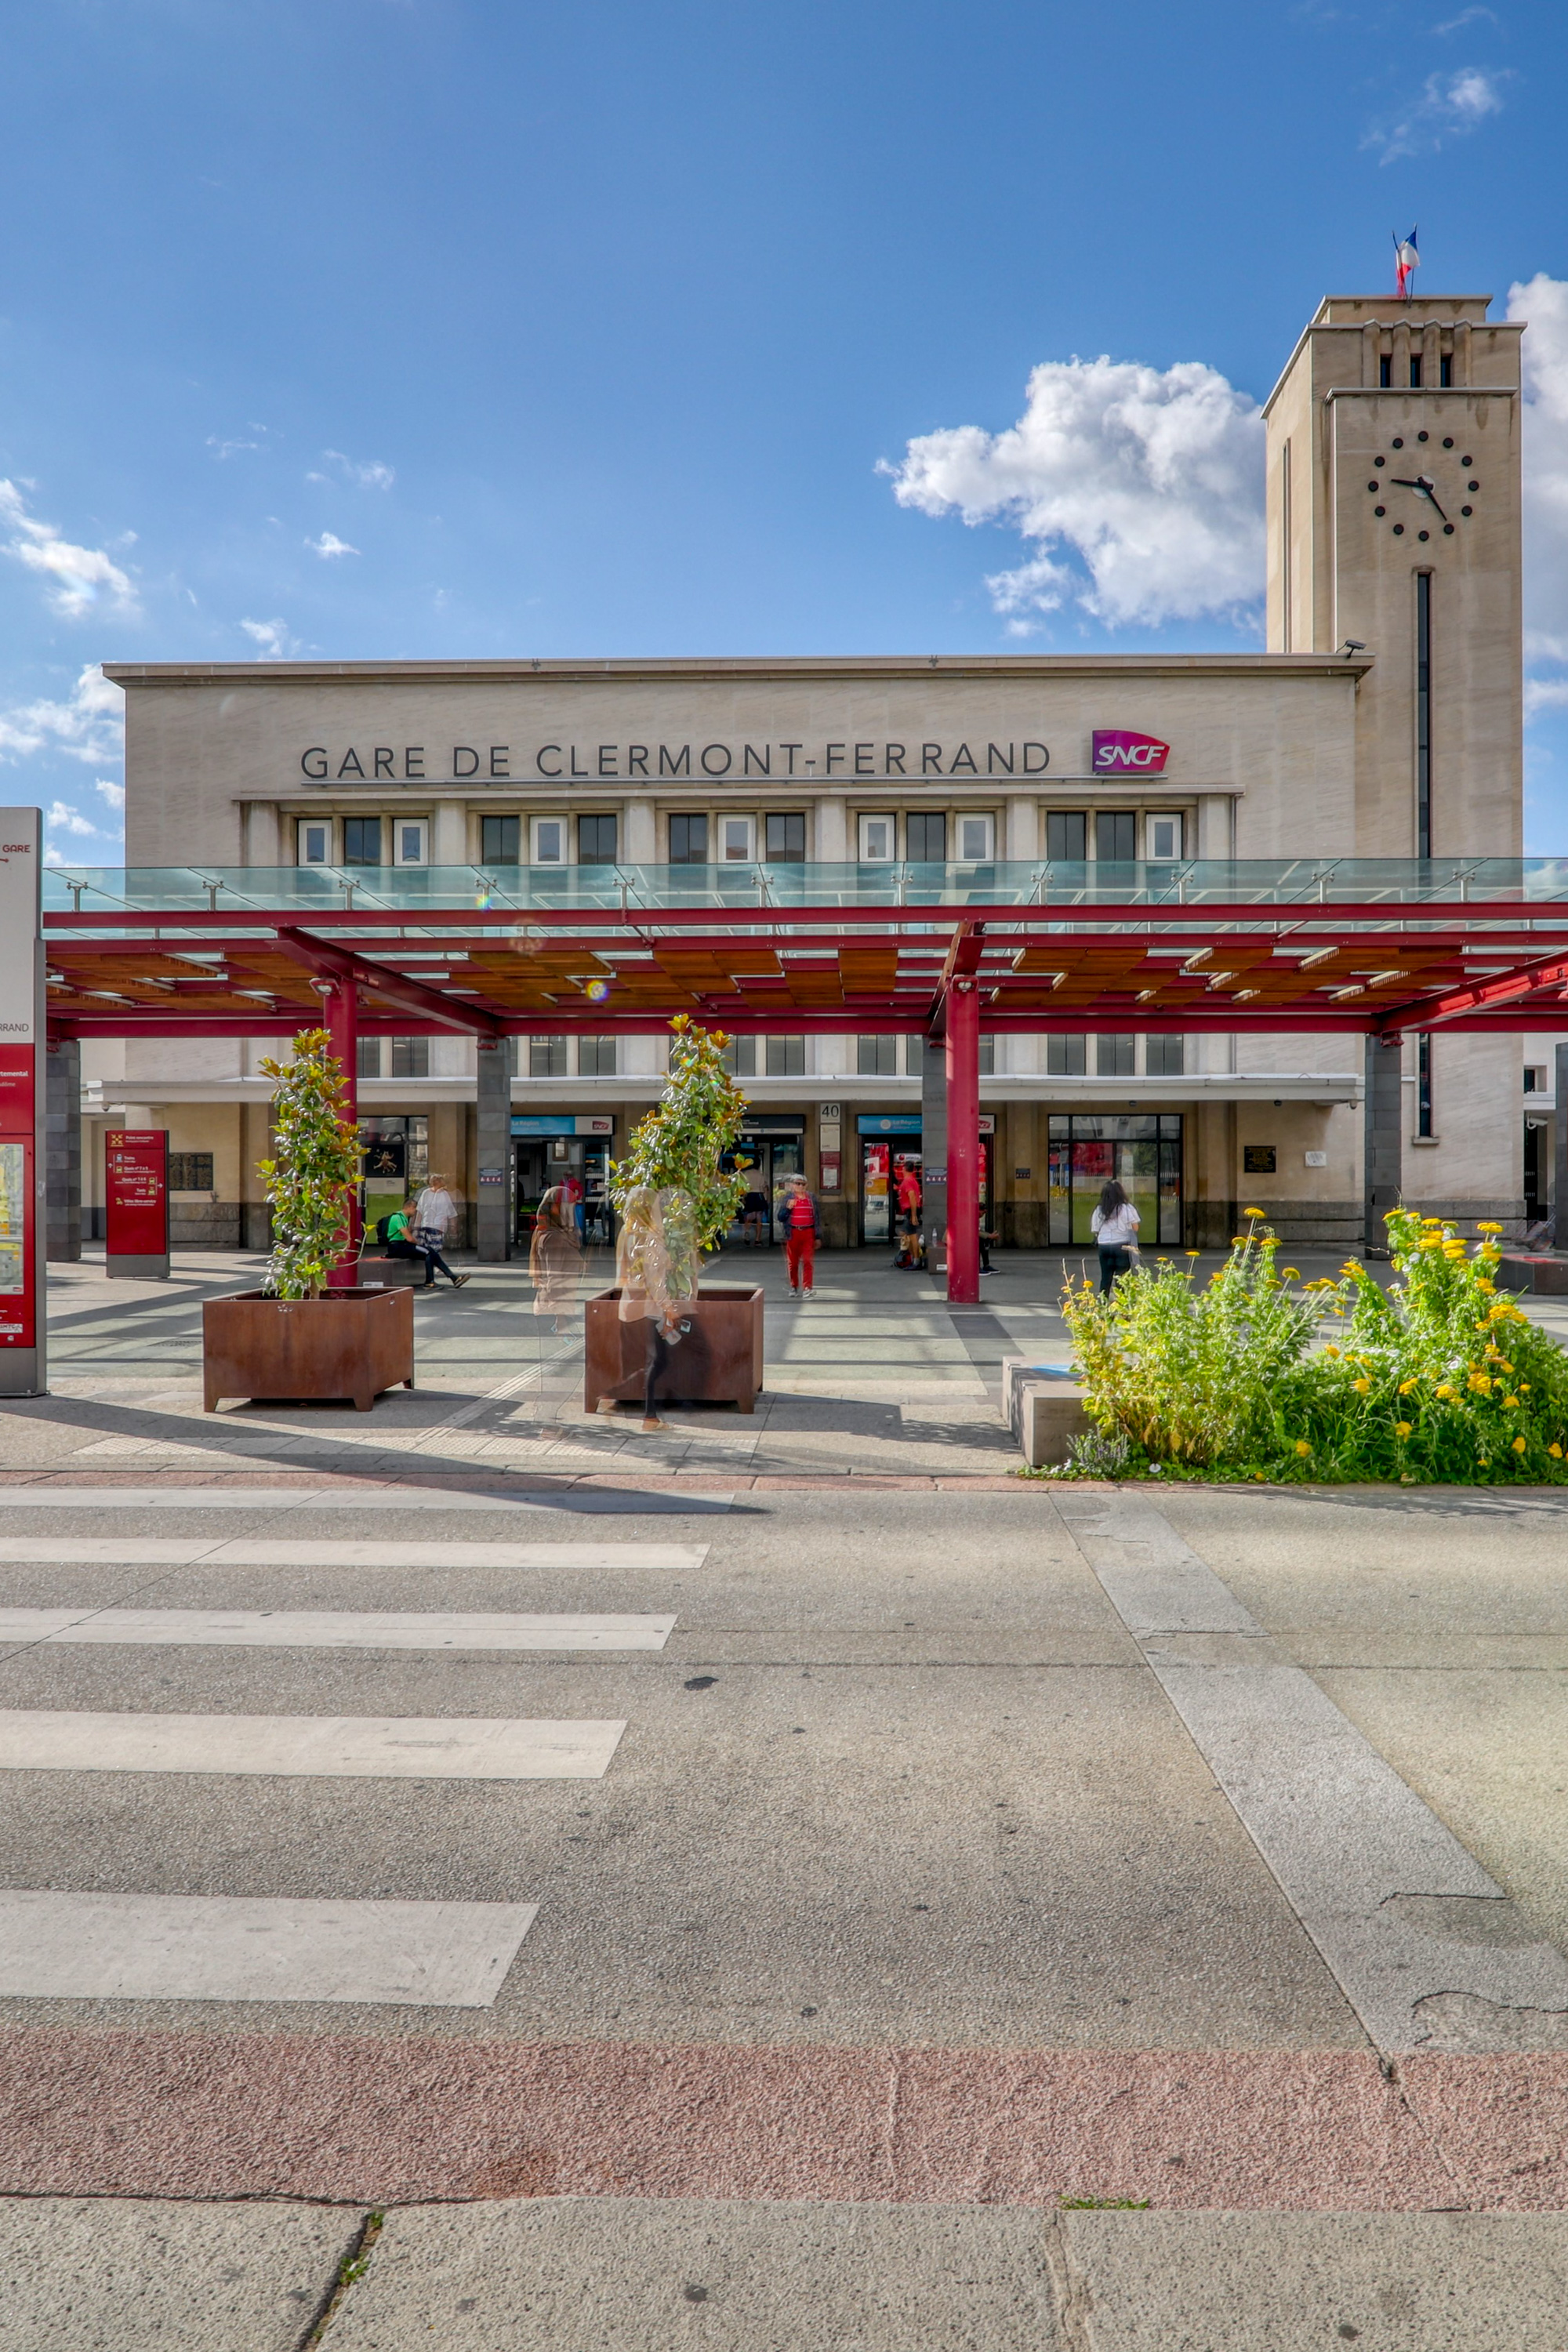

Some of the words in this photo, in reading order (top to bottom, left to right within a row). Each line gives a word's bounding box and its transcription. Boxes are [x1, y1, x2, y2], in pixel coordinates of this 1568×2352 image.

[300, 746, 426, 779] GARE
[453, 746, 510, 778] DE
[536, 742, 1050, 777] CLERMONT-FERRAND
[1095, 746, 1165, 766] SNCF
[2, 844, 31, 853] GARE
[822, 1105, 839, 1117] 40
